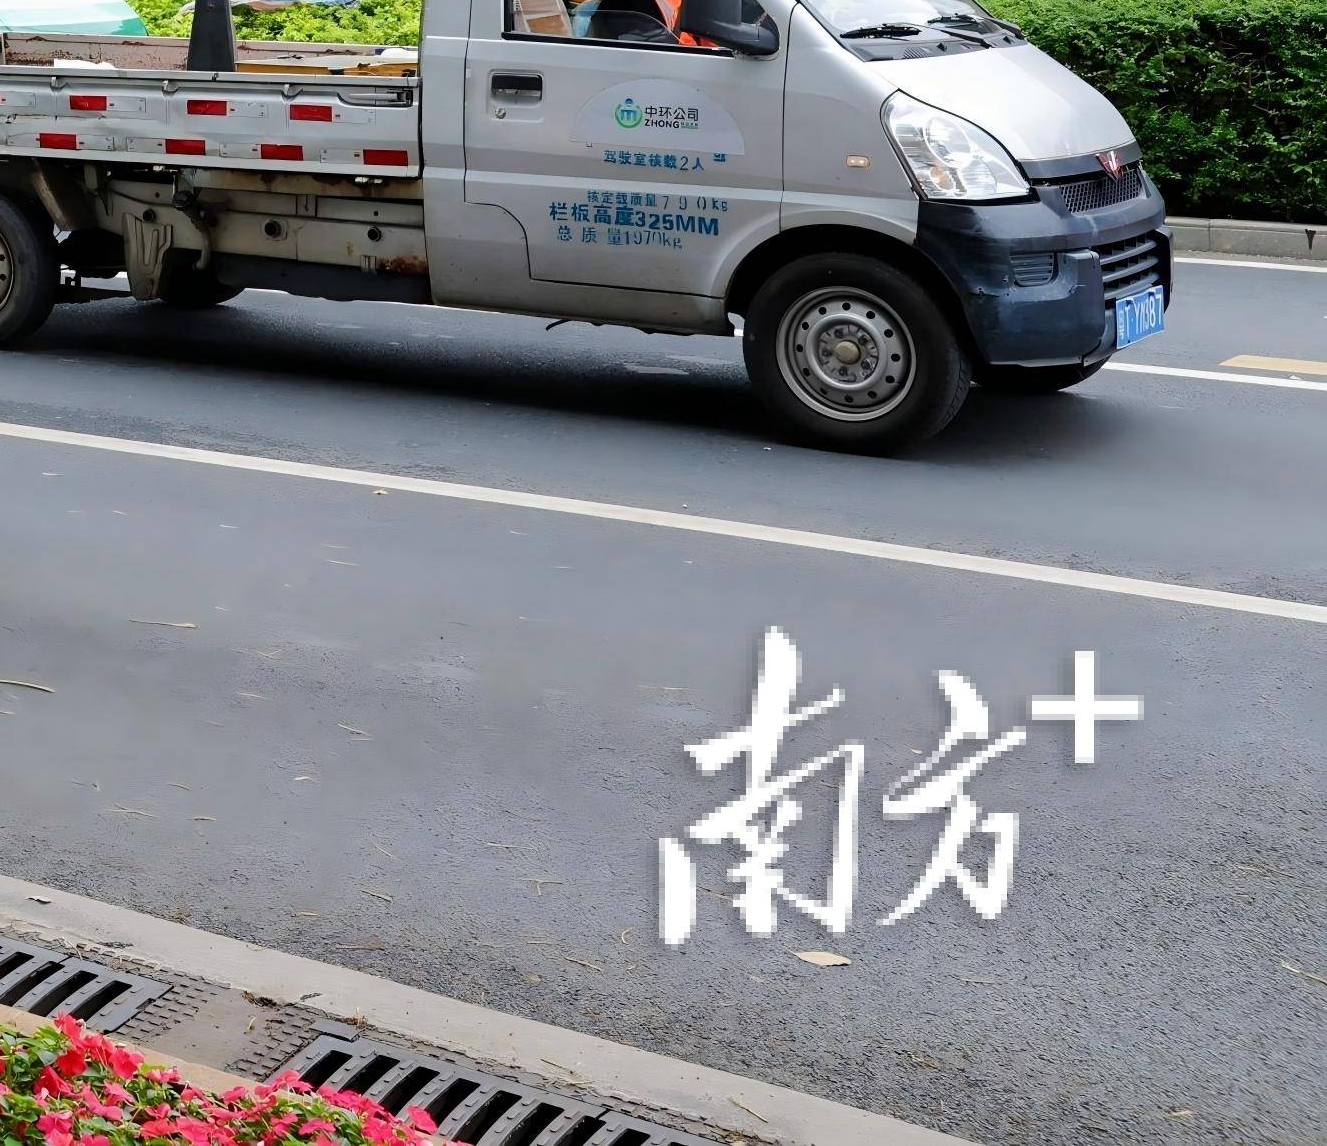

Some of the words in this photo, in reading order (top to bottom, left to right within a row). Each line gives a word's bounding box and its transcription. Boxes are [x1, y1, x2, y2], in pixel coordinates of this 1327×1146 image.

[644, 105, 699, 121] 中环公司
[644, 119, 680, 129] ZHONG
